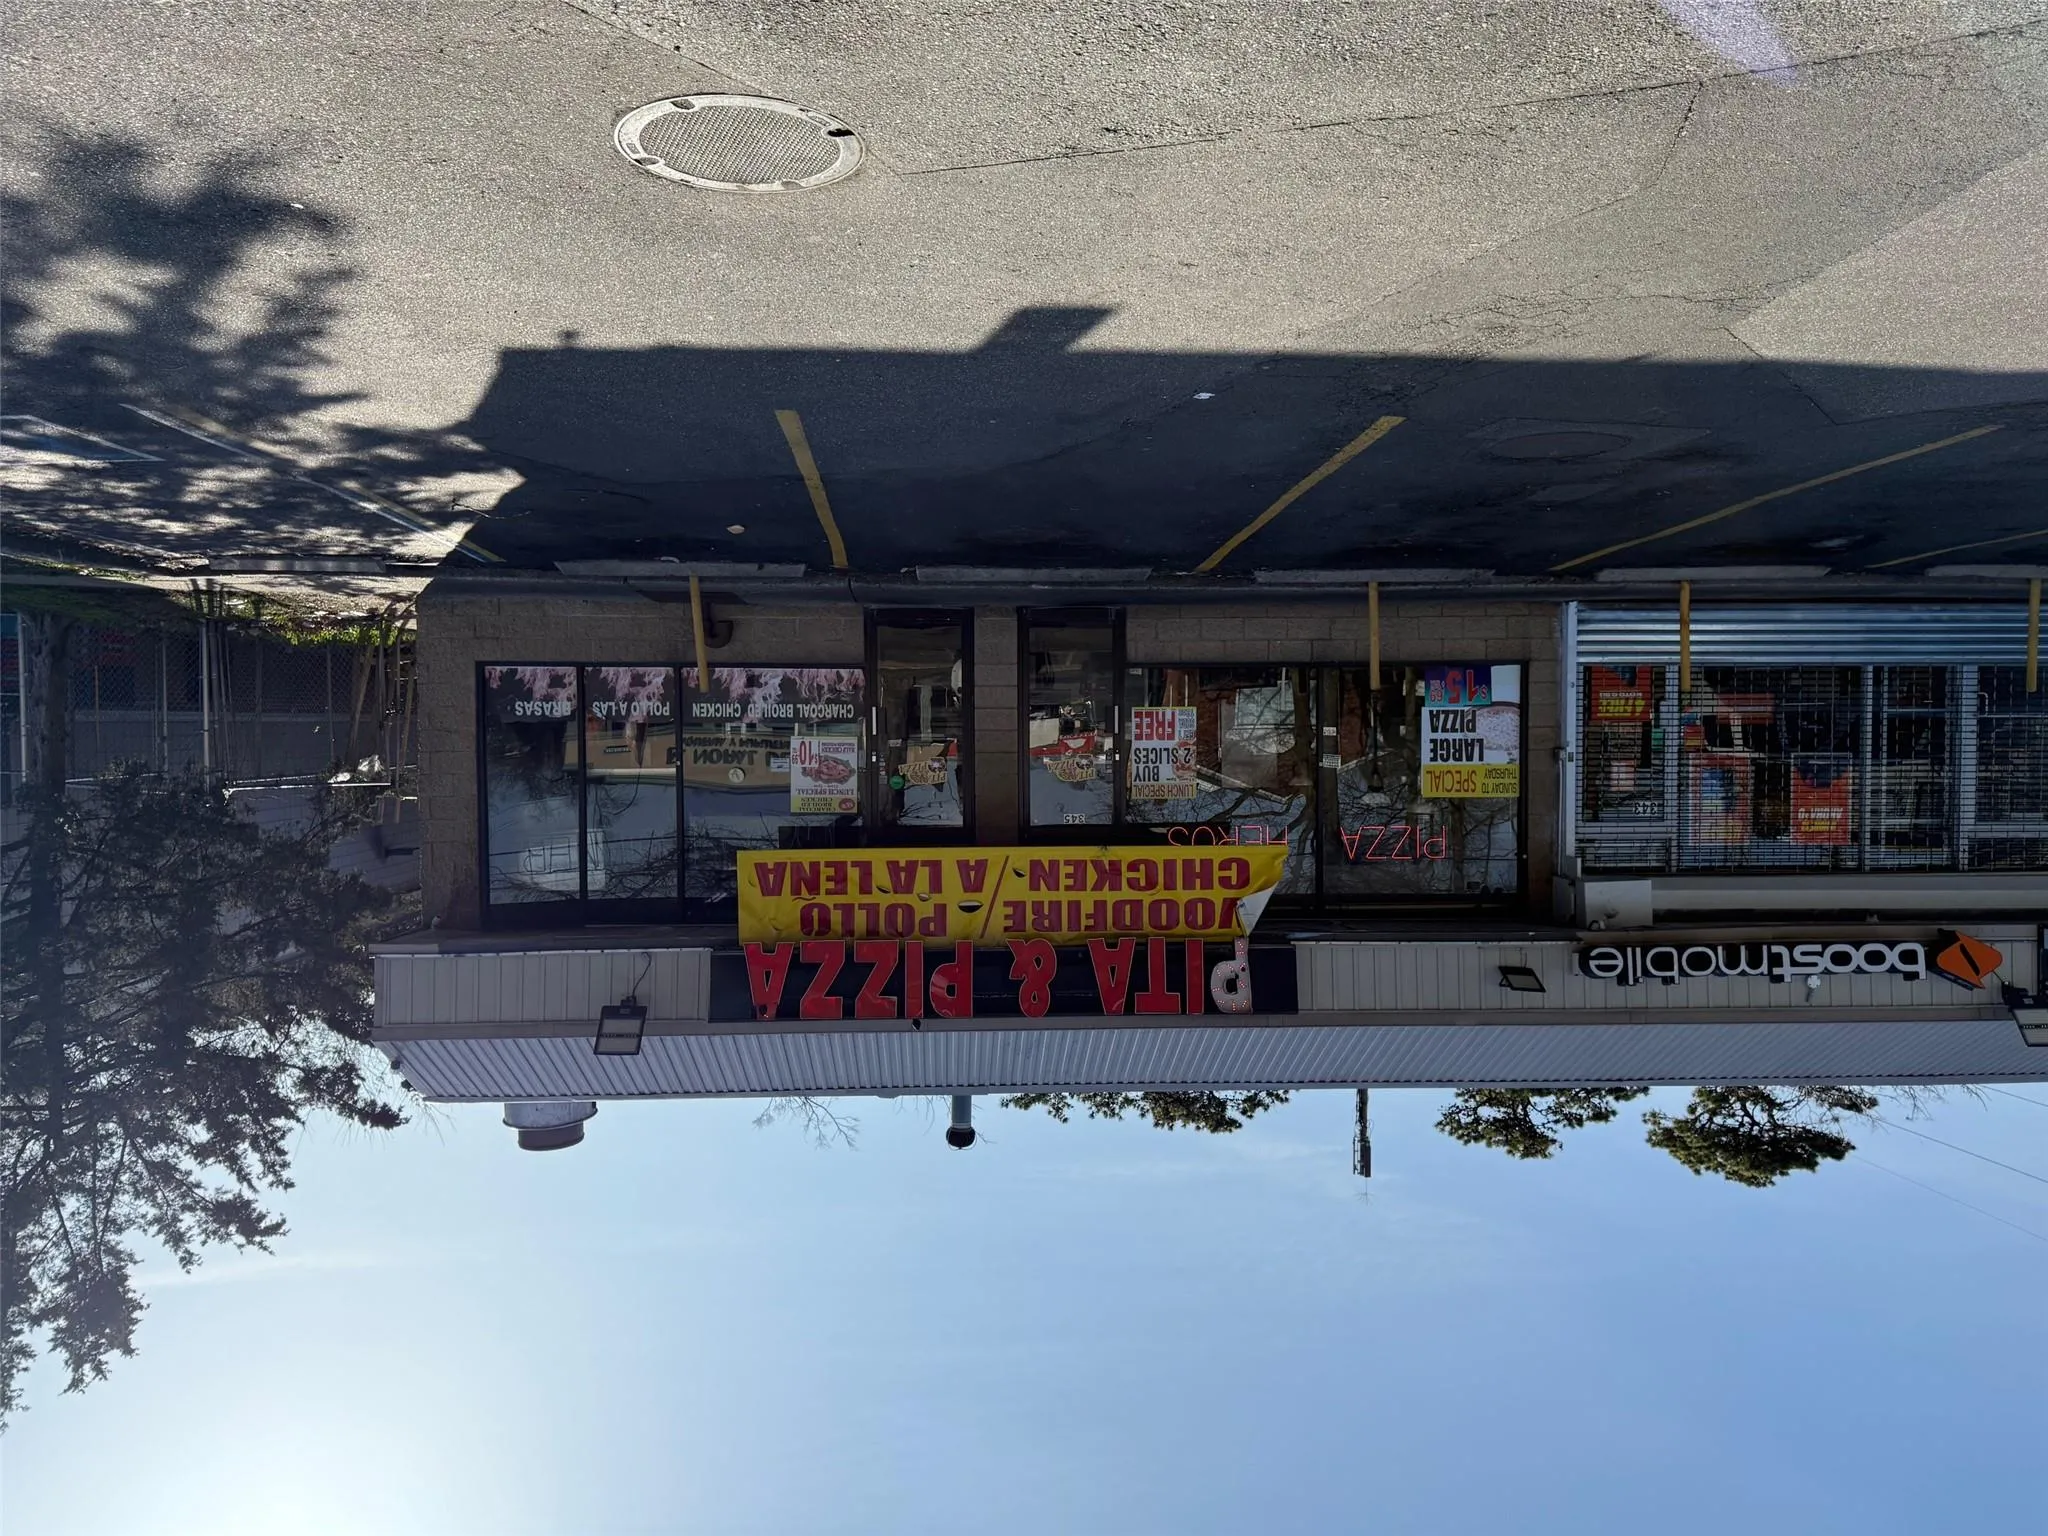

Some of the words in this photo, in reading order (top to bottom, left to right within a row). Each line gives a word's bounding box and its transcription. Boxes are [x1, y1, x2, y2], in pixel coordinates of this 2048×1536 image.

[514, 700, 572, 717] BRASAS
[592, 701, 616, 716] LAS
[618, 701, 628, 716] A
[631, 701, 670, 716] POLLO
[692, 702, 742, 718] CHICKEN
[747, 703, 794, 718] BROILED
[796, 703, 855, 718] CHARCOAL
[1134, 711, 1176, 741] FREE
[1428, 709, 1477, 734] PIZZA
[1133, 747, 1179, 765] SLICES
[1183, 747, 1191, 764] 2
[1429, 738, 1484, 762] LARGE
[1133, 765, 1160, 782] BUY
[1425, 770, 1477, 793] SPECIAL
[1483, 767, 1517, 779] THURSDAY
[796, 788, 828, 796] SPECIAL
[829, 788, 854, 796] LUNCH
[1133, 784, 1166, 798] SPECIAL
[1167, 784, 1194, 798] LUNCH
[1481, 782, 1490, 794] TO
[1491, 782, 1517, 794] SUNDAY
[1634, 803, 1657, 815] 343
[1064, 814, 1085, 823] 345
[1340, 824, 1447, 861] PIZZA
[754, 861, 873, 903] LEÑA
[885, 859, 943, 895] LA
[956, 859, 988, 893] A
[1029, 857, 1251, 893] CHICKEN
[799, 903, 947, 938] POLLO
[744, 940, 973, 1019] PIZZA
[1006, 938, 1057, 1018] &
[1087, 937, 1253, 1016] PITA
